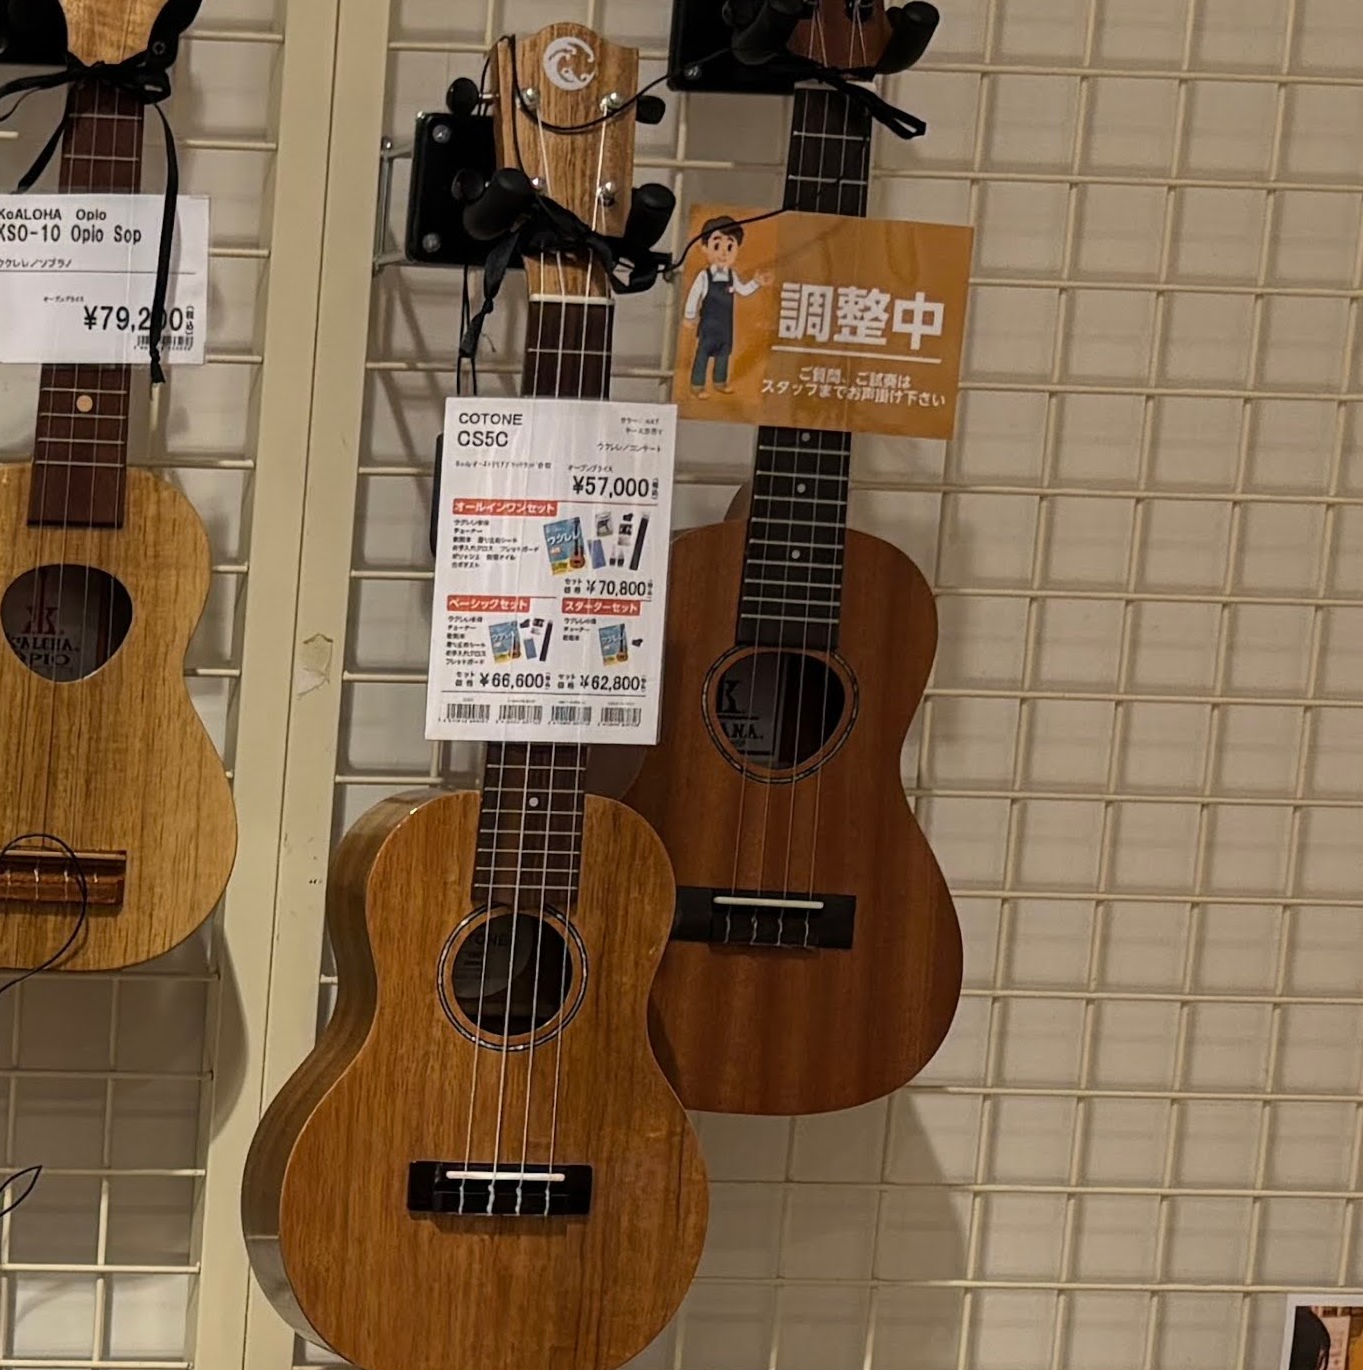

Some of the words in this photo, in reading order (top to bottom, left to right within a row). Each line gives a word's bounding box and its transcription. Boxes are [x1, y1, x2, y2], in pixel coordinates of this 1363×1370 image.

[114, 225, 142, 245] Sop
[778, 282, 945, 351] 調整中
[459, 413, 524, 425] COTONE
[457, 431, 509, 447] CS5C
[573, 476, 650, 498] ¥57,000
